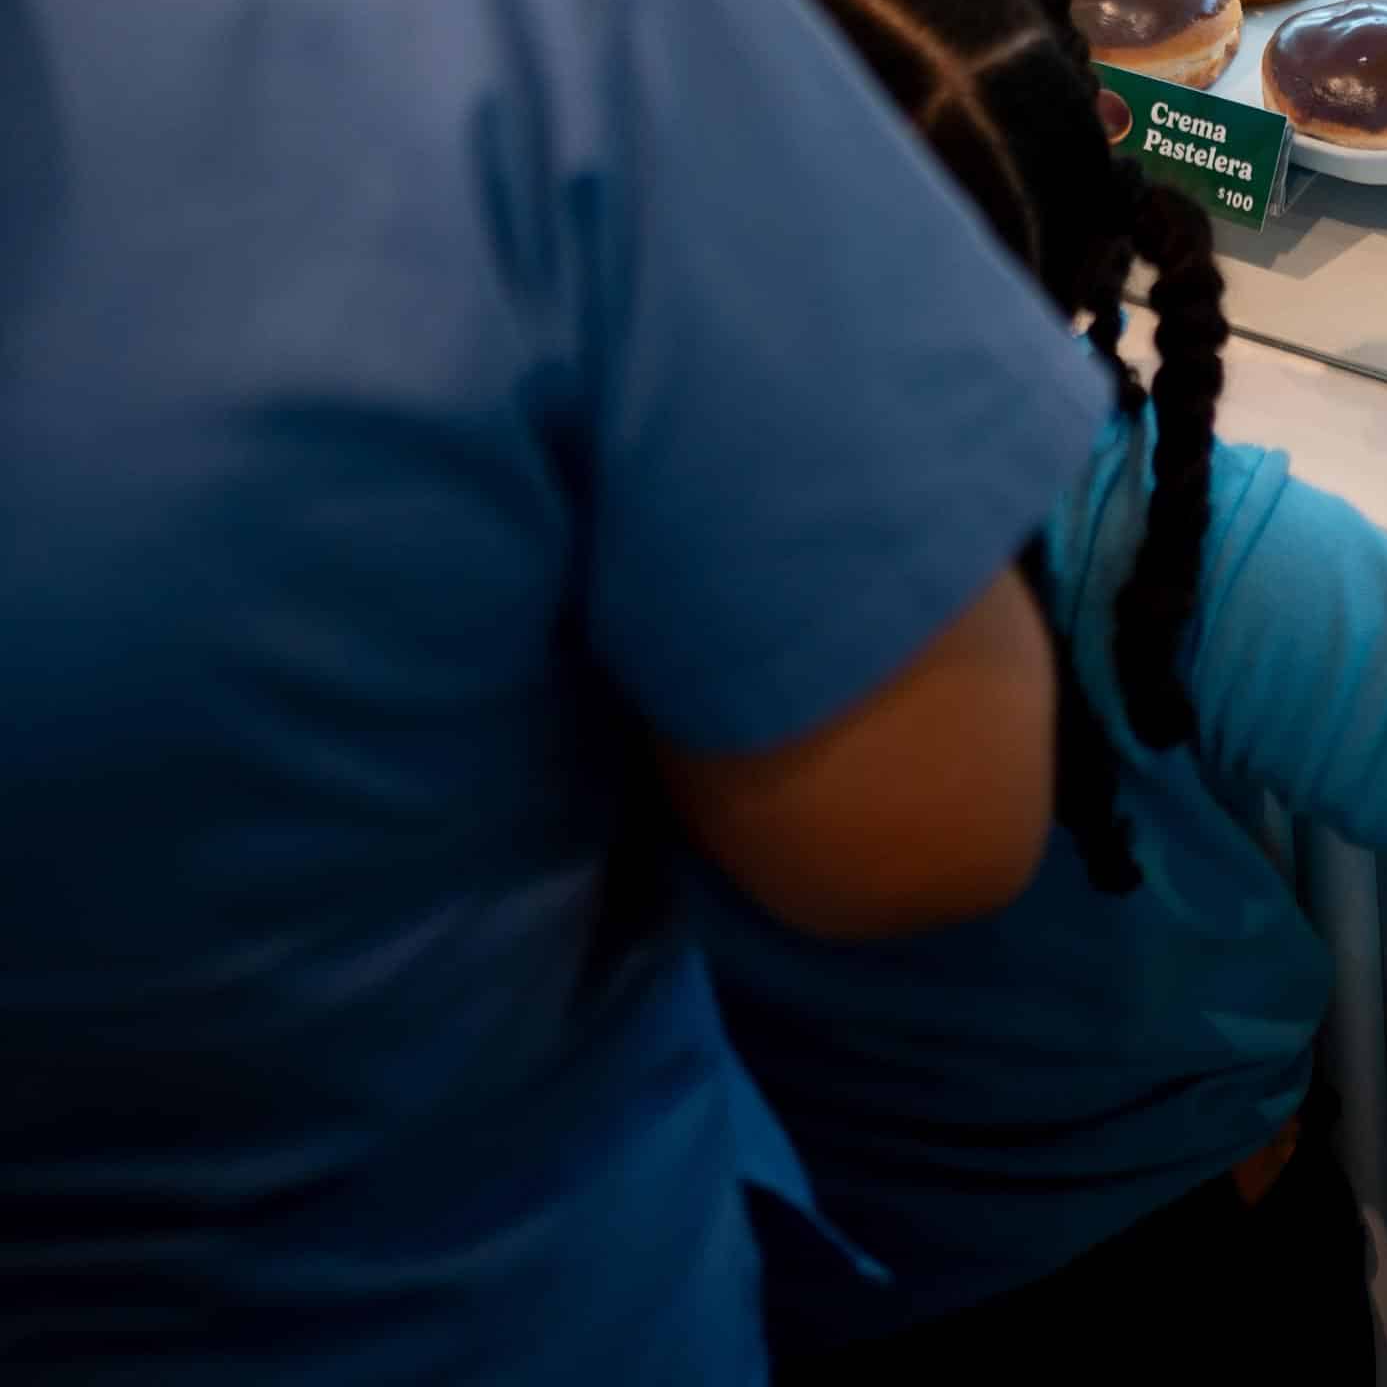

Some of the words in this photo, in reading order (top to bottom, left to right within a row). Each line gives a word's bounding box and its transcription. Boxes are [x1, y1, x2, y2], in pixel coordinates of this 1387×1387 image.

[1151, 101, 1227, 143] Crema
[1143, 129, 1253, 181] Pastelera
[1217, 187, 1254, 212] $100
